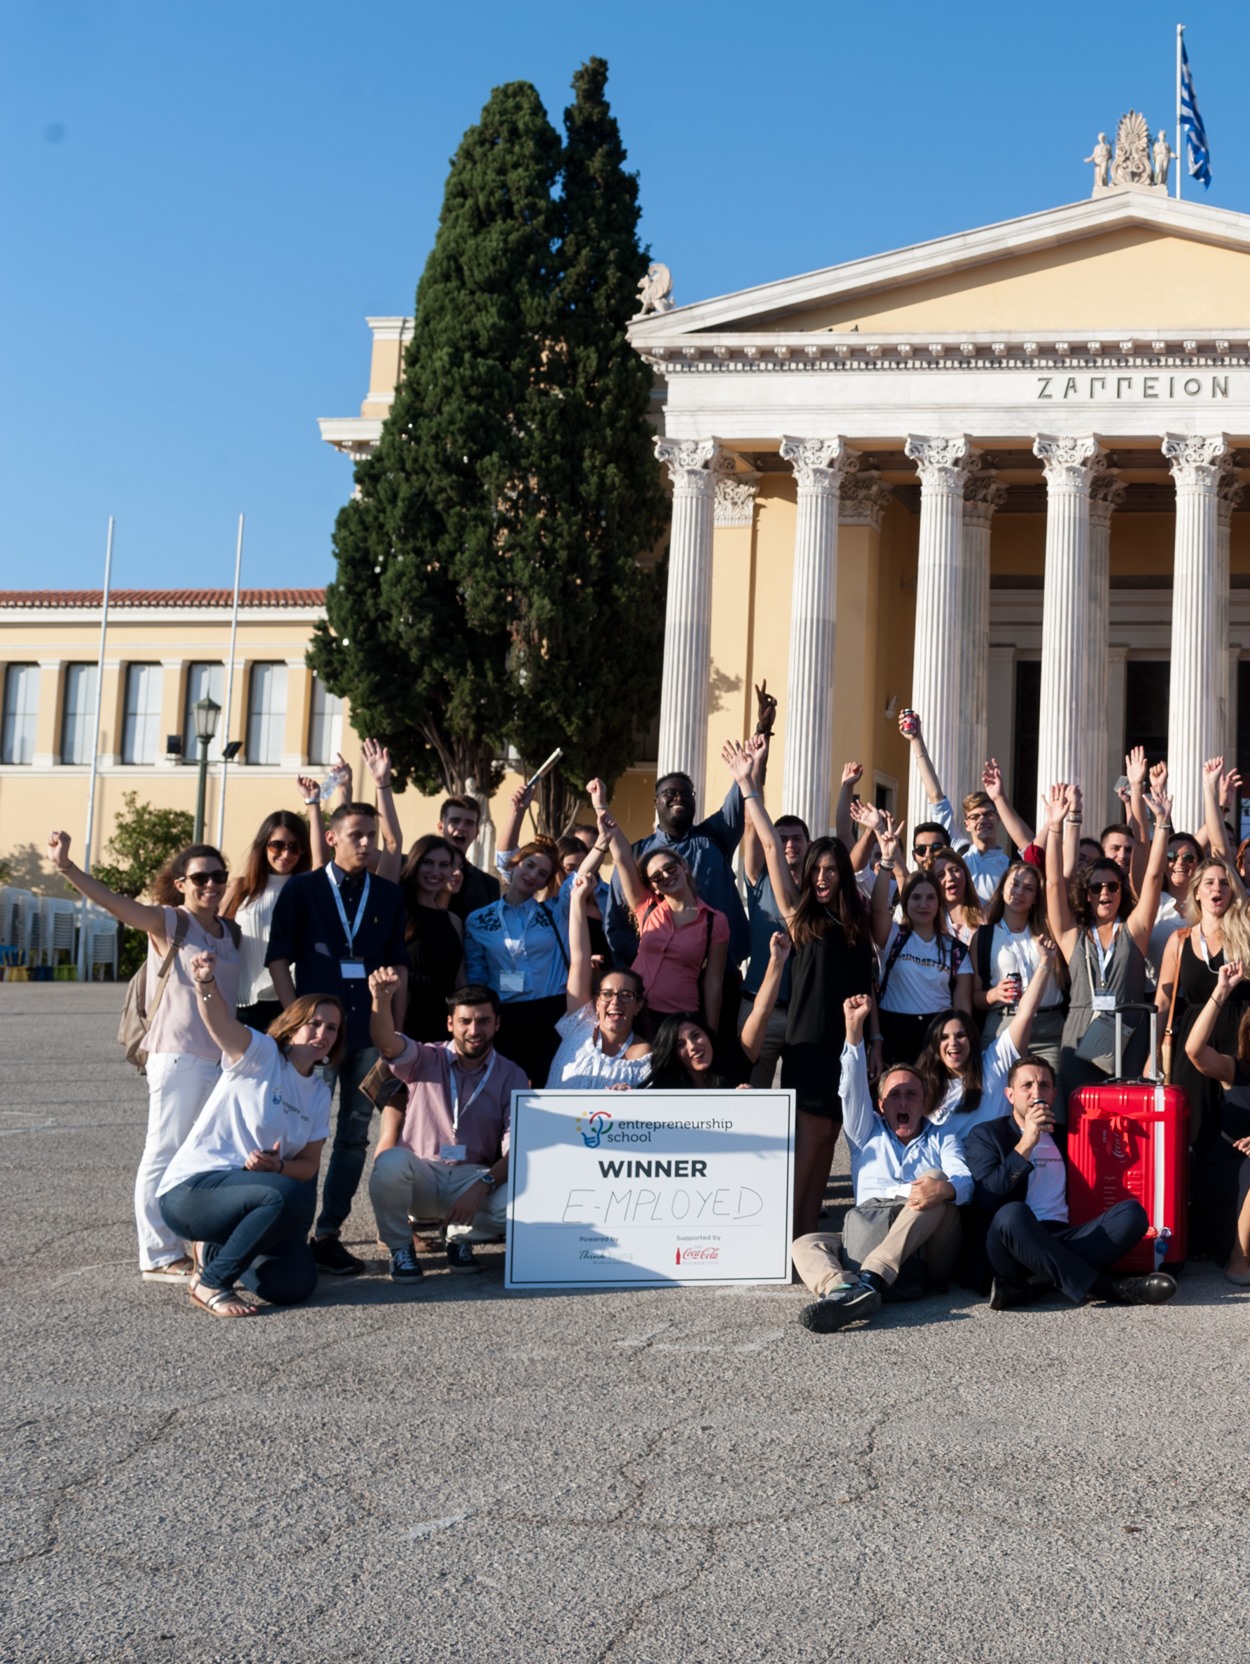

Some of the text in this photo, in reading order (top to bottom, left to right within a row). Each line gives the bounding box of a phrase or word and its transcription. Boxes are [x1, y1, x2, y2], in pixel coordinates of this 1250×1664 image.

[618, 1118, 733, 1132] entrepreneurship
[607, 1131, 652, 1143] school
[598, 1160, 707, 1178] WINNER
[562, 1187, 763, 1224] E-MPLOYED
